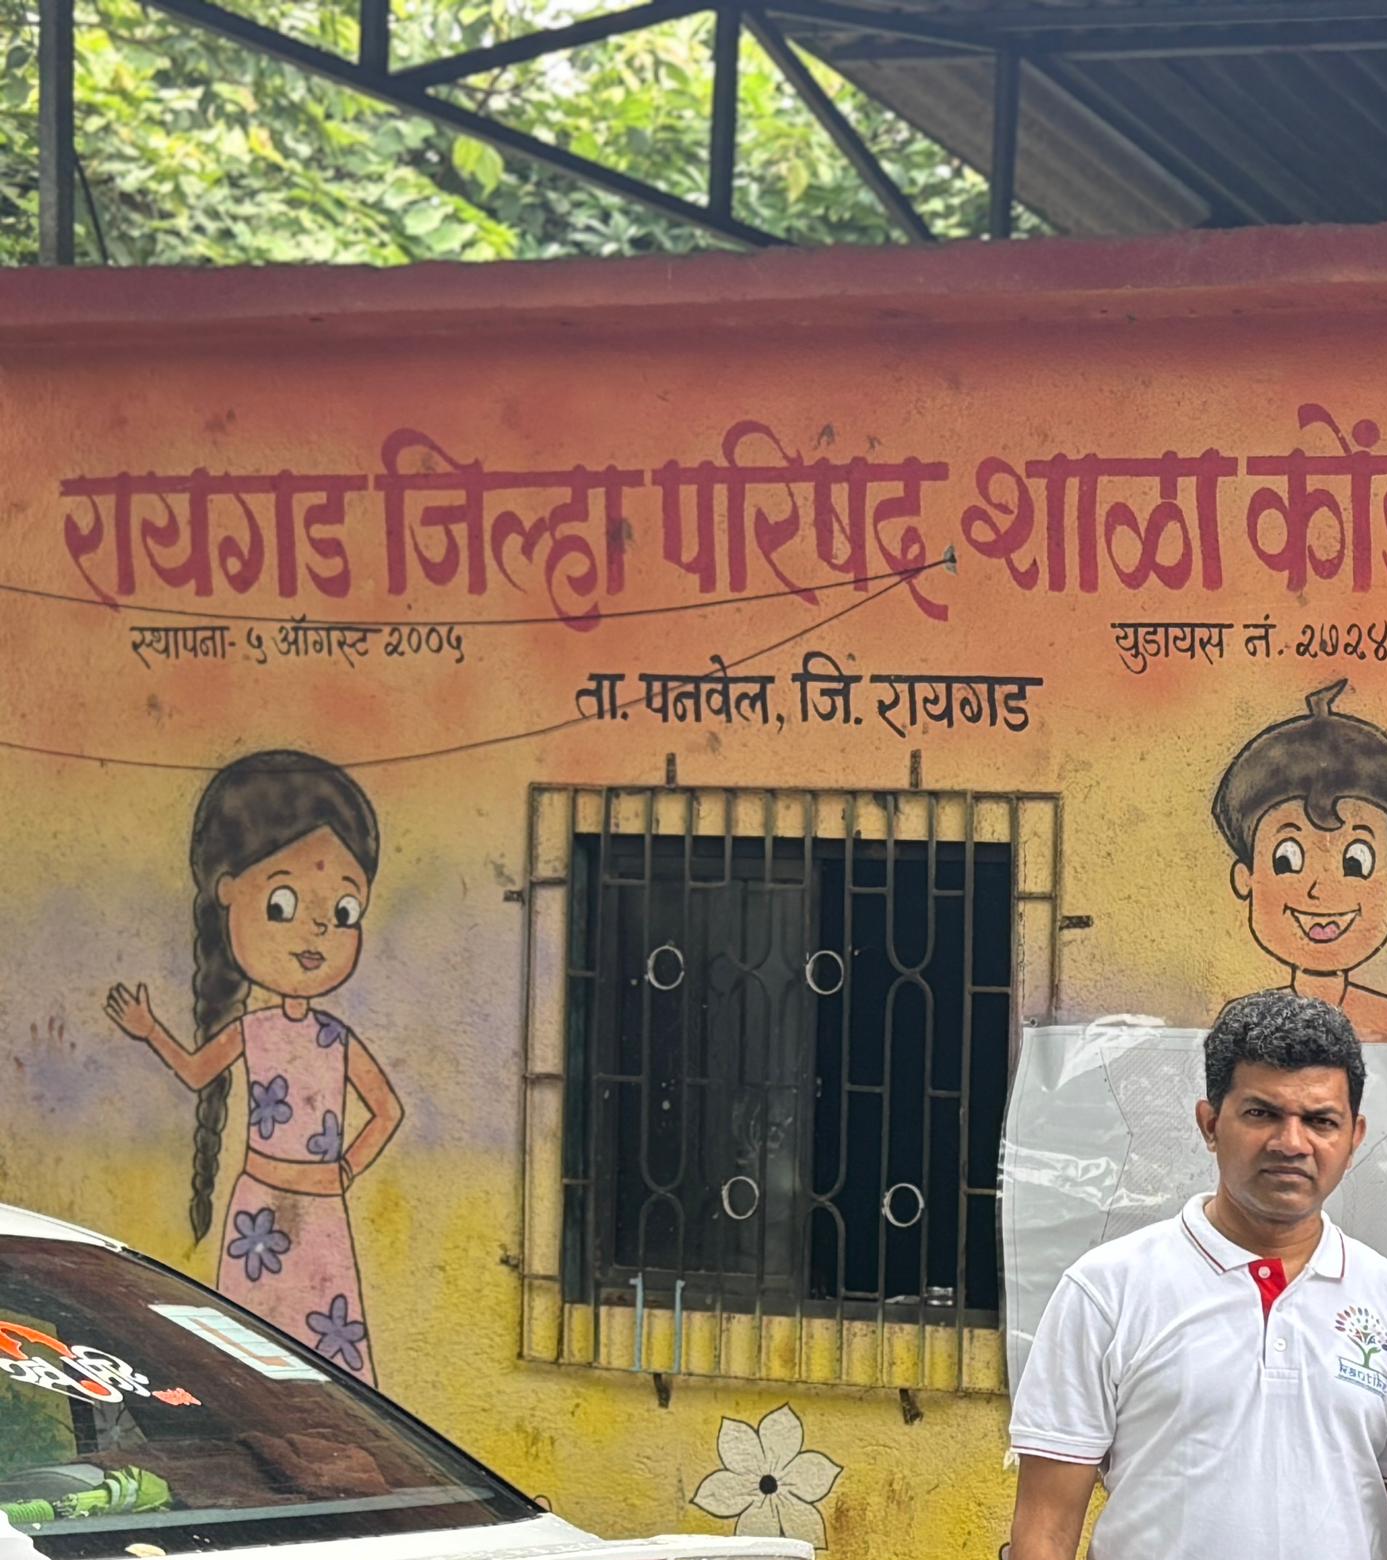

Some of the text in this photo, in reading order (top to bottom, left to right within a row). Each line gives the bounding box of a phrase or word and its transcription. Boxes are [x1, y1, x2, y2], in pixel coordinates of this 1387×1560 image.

[60, 466, 368, 613] रायगड
[374, 427, 645, 633] जिल्हा
[652, 419, 948, 621] परिषद
[961, 450, 1238, 594] शाळा
[247, 629, 267, 664] ५
[273, 613, 383, 668] ऑगस्ट
[384, 625, 465, 664] २००५
[1111, 623, 1233, 673] युडायस
[576, 672, 629, 720] ता.
[870, 676, 1044, 738] रायगड
